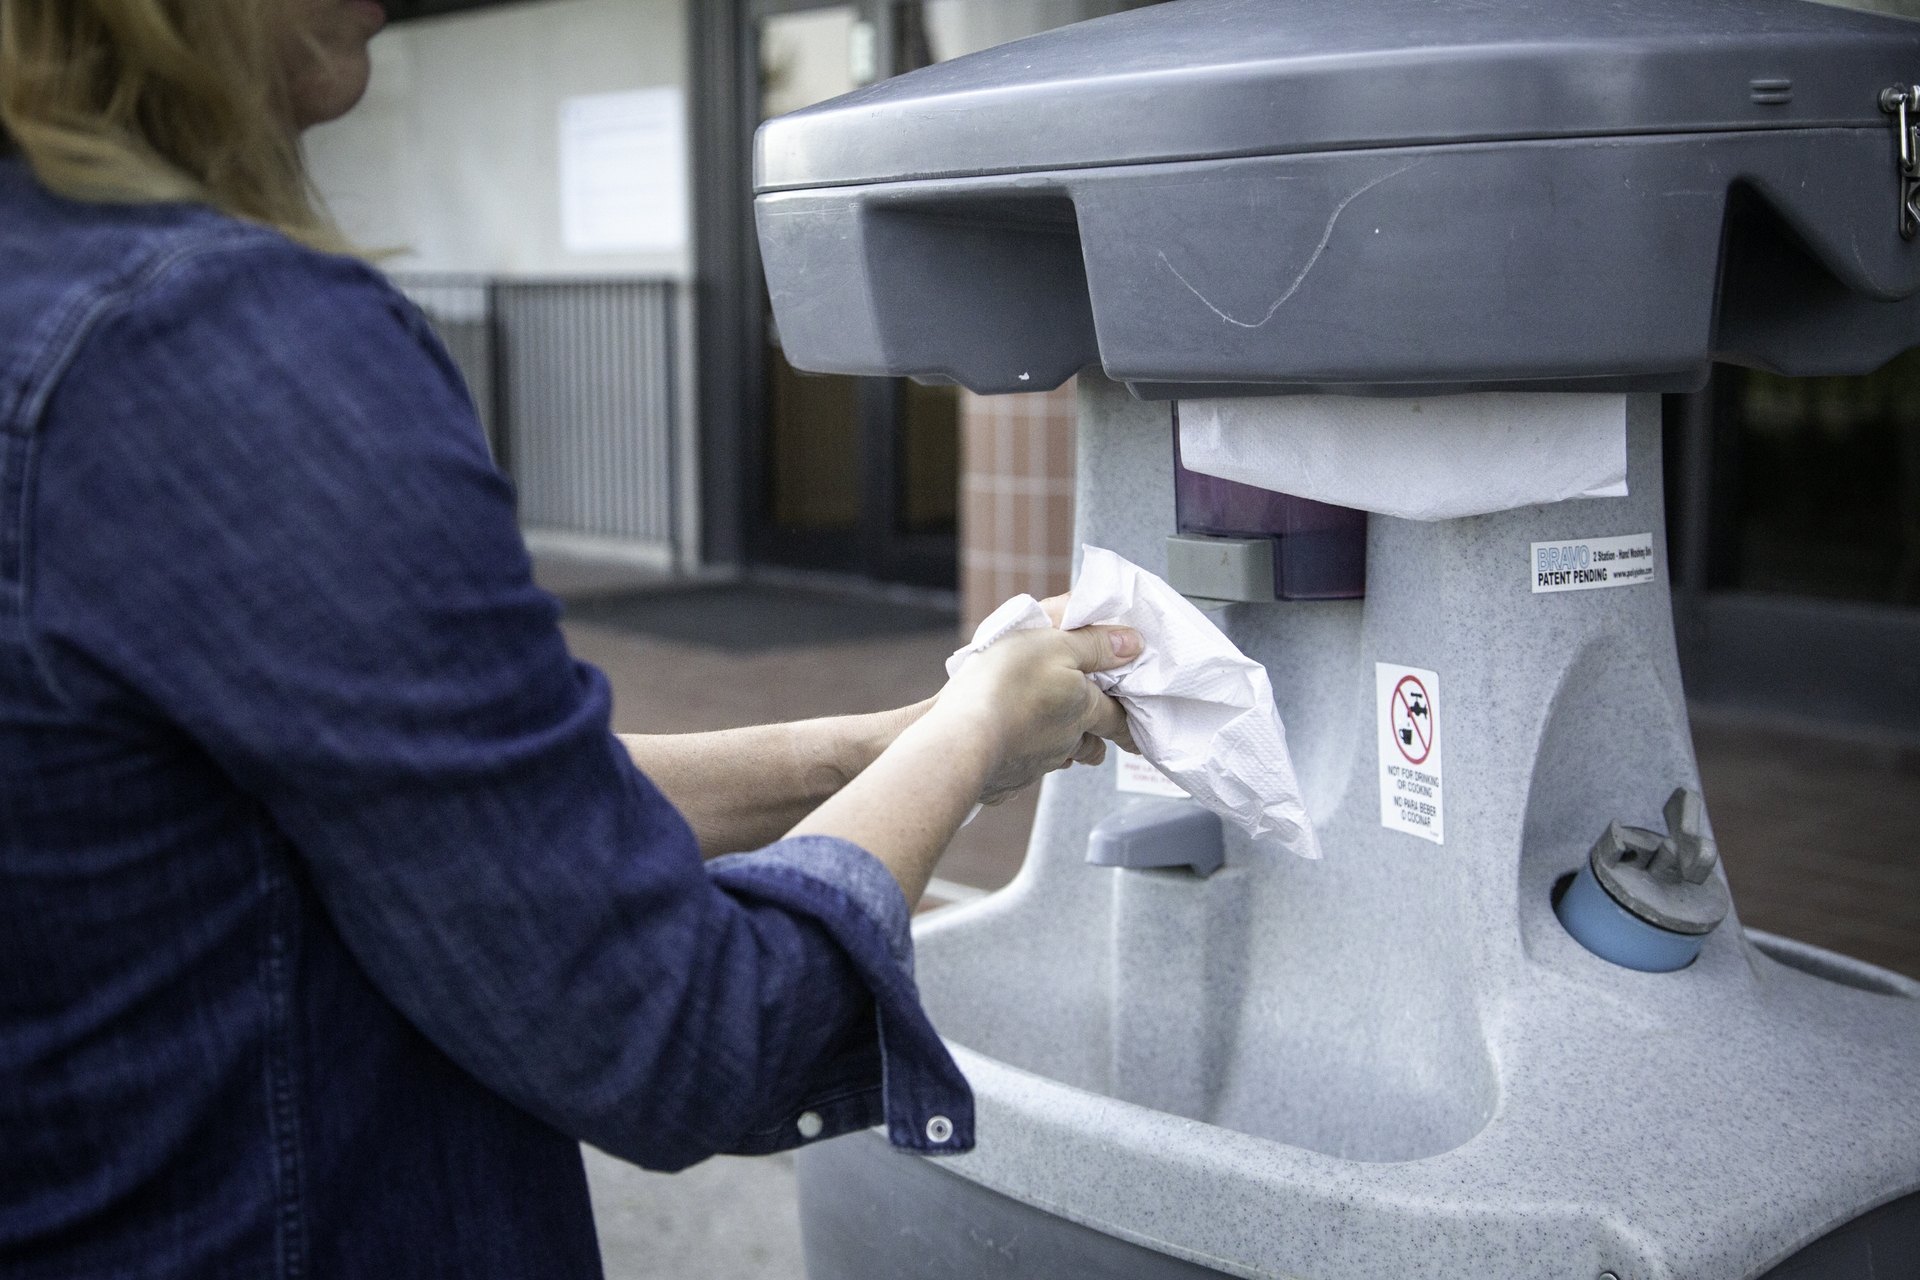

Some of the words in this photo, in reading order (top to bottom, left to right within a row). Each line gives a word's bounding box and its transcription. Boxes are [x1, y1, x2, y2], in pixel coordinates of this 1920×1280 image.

[1537, 545, 1590, 572] BRAVO
[1593, 551, 1597, 562] 2
[1598, 550, 1615, 561] Station
[1538, 571, 1571, 586] PATENT
[1574, 568, 1608, 583] PENDING
[1388, 765, 1400, 777] NOT
[1402, 768, 1413, 779] FOR
[1415, 771, 1439, 788] DRINKING
[1397, 779, 1406, 790] OR
[1408, 781, 1432, 798] COOKING
[1394, 796, 1402, 807] NO
[1404, 798, 1418, 811] PARA
[1420, 802, 1436, 817] BEBER
[1402, 809, 1406, 820] O
[1408, 811, 1431, 828] COCINAR
